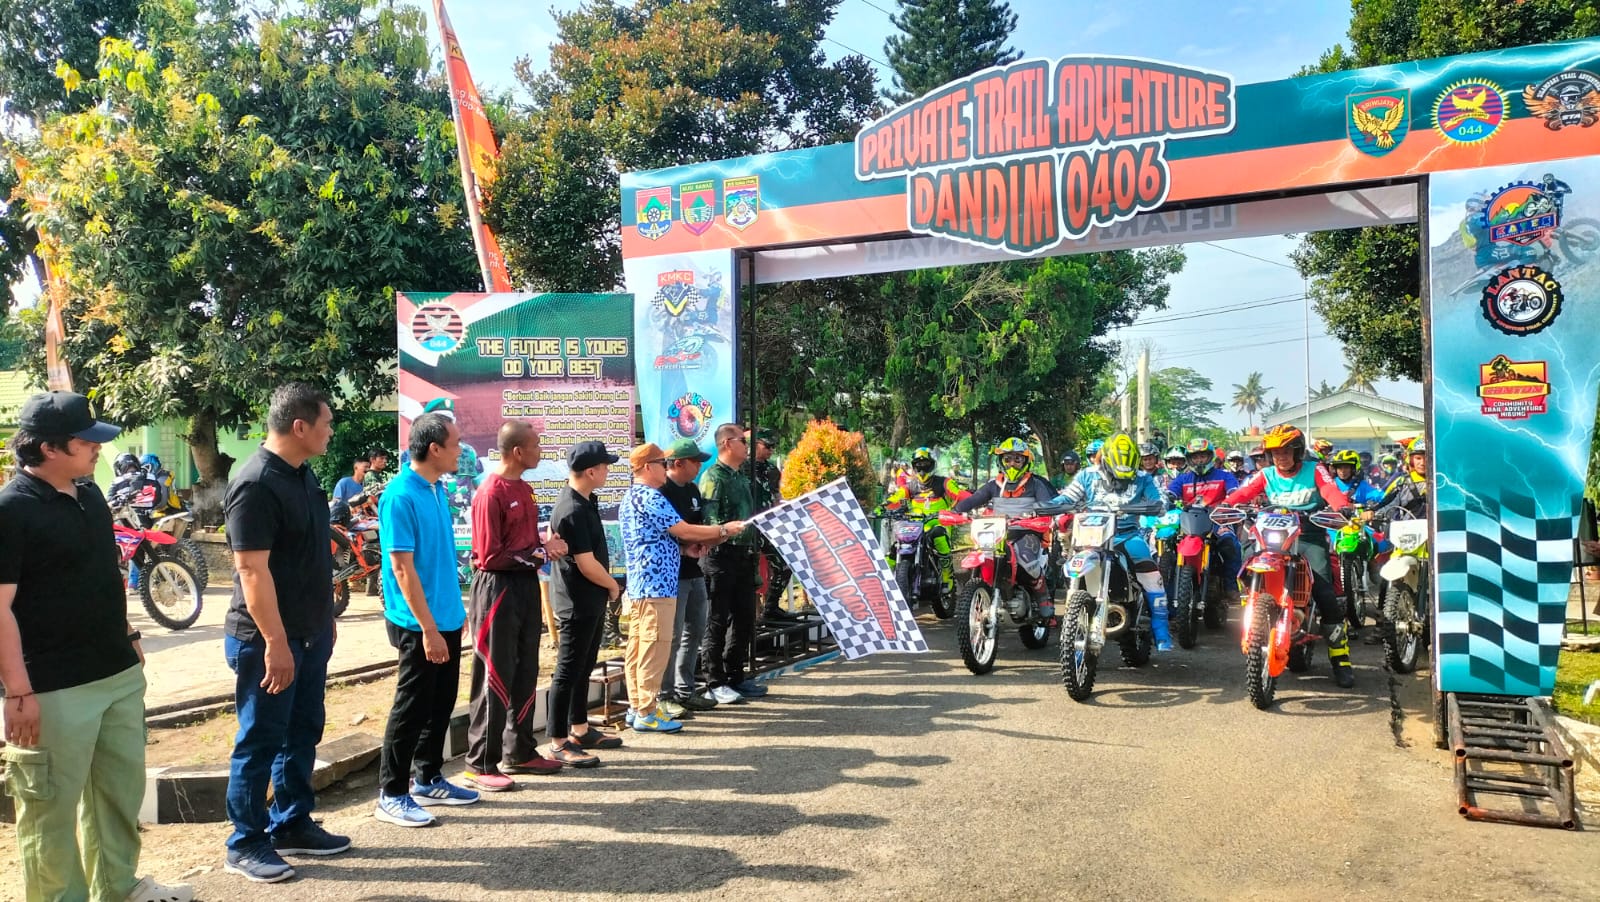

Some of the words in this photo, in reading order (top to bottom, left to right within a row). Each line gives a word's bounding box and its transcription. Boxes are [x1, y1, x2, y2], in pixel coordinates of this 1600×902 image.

[1361, 100, 1395, 111] SRIWIJAYA
[862, 88, 969, 172] PRIVATE
[973, 67, 1051, 156] TRAIL
[1058, 64, 1227, 144] ADVENTURE
[1458, 124, 1483, 136] 044
[913, 160, 1057, 249] DANDIM
[1066, 146, 1162, 231] 0406
[1487, 268, 1557, 295] LANTAC
[477, 338, 504, 356] THE
[510, 338, 561, 360] FUTURE
[566, 338, 581, 356] IS
[585, 338, 629, 356] YOURS
[503, 358, 524, 376] DO
[528, 358, 564, 376] YOUR
[569, 358, 603, 380] BEST
[535, 390, 549, 401] Baik
[574, 390, 593, 401] Sakiti
[595, 390, 614, 403] Orang
[615, 390, 629, 401] Lain
[503, 406, 523, 416] Kalau
[524, 406, 543, 416] Kamu
[544, 405, 563, 416] Tidak
[564, 406, 583, 416] Bantu
[585, 406, 608, 417] Banyak
[610, 406, 629, 417] Orang
[545, 420, 575, 431] Bantulah
[576, 420, 607, 432] Beberapa
[540, 435, 554, 445] Bisa
[555, 435, 575, 445] Bantu
[540, 451, 560, 462] rang,
[804, 501, 856, 548] PRIVATE
[1263, 517, 1290, 527] 415
[835, 541, 876, 579] TRAIL
[799, 530, 849, 588] DANDIM
[830, 586, 872, 622] 0406
[855, 578, 897, 641] ADVENTURE
